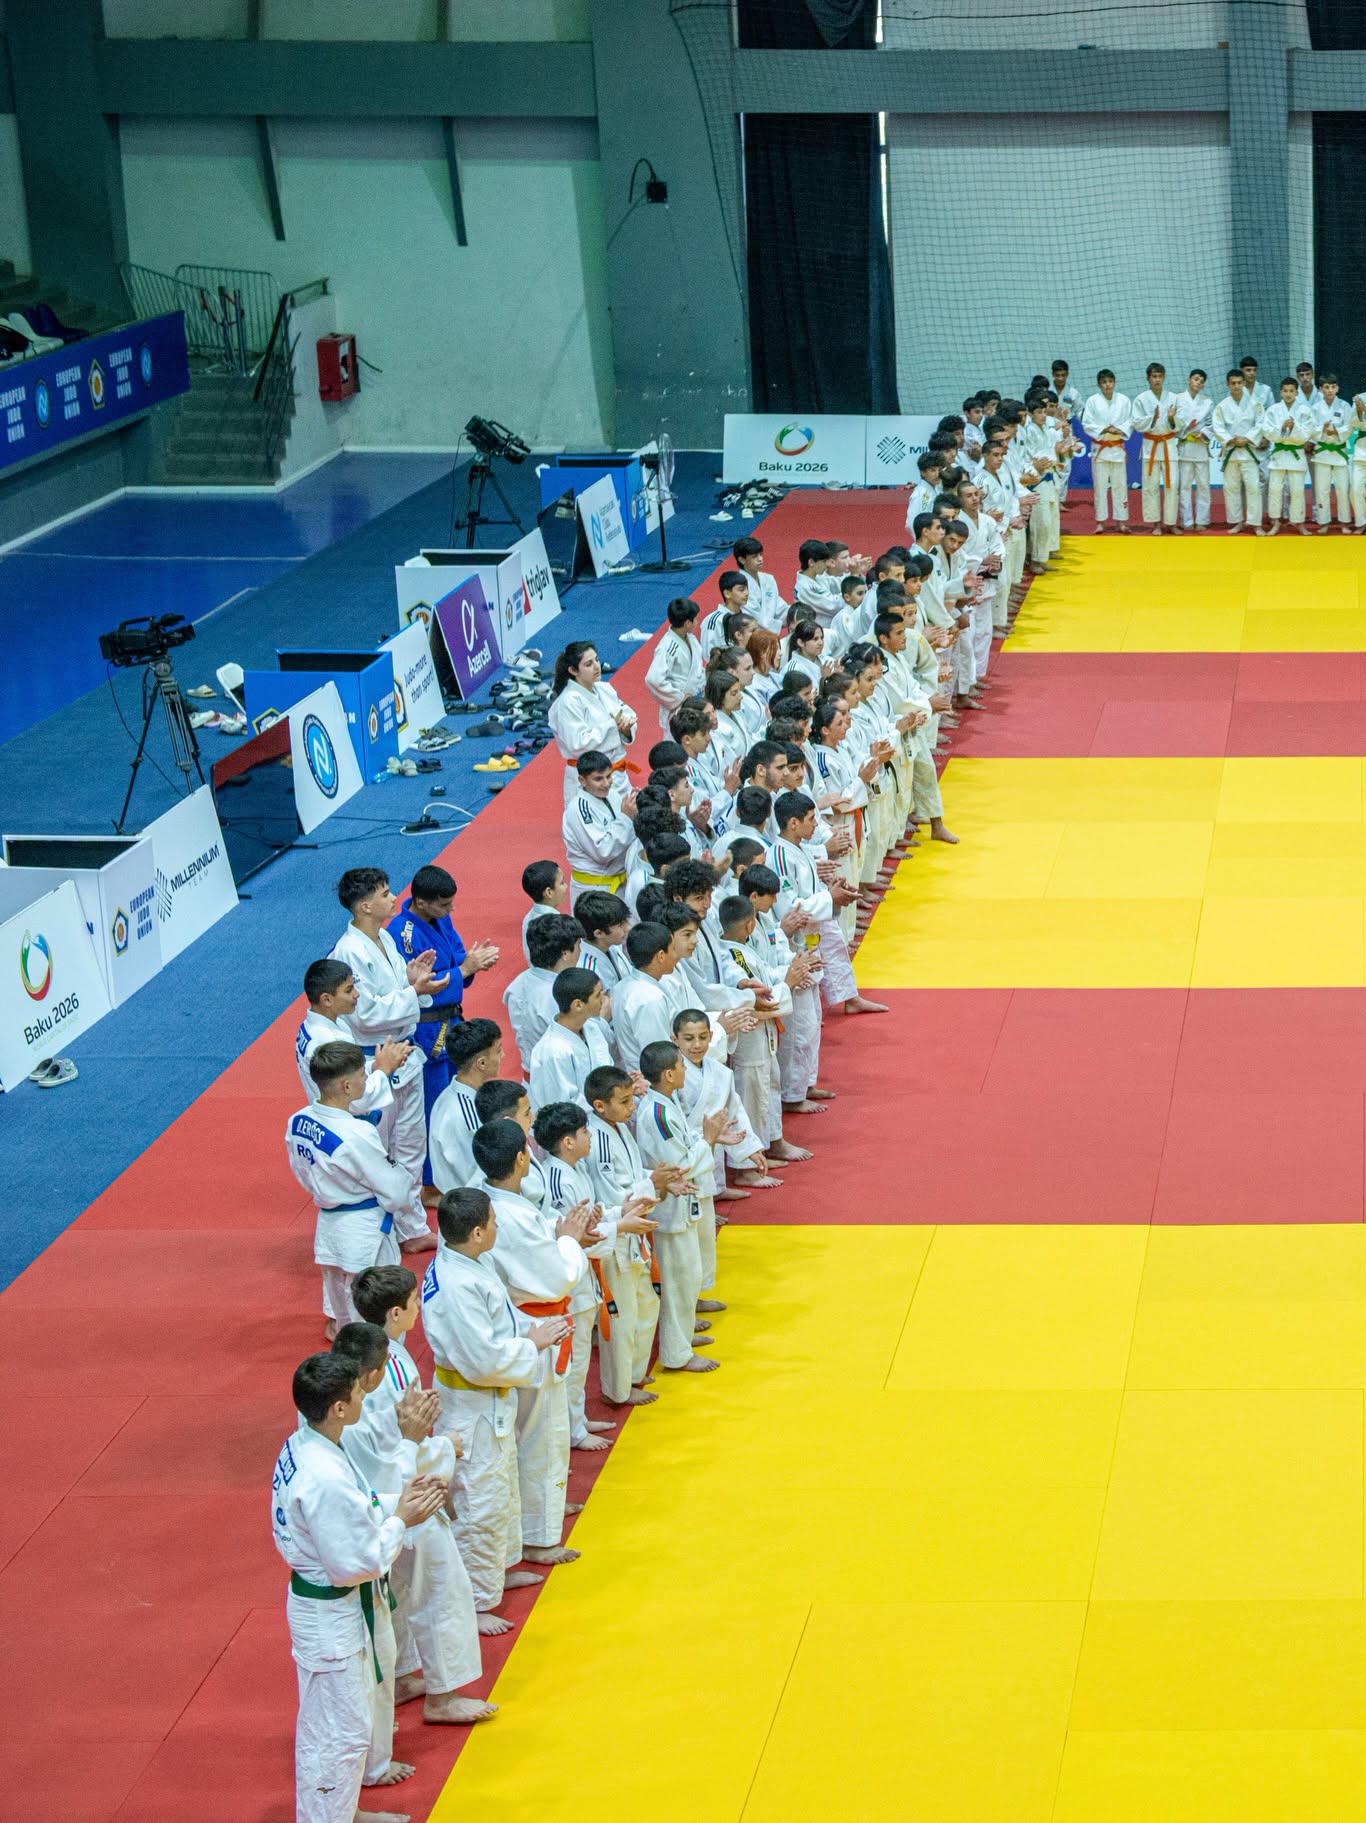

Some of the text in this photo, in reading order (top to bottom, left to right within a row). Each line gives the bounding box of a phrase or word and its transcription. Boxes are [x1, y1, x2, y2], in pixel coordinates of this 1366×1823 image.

[759, 462, 828, 472] Baku 2026
[525, 565, 550, 600] triglav
[170, 844, 220, 892] MILLENNIUM
[129, 885, 155, 913] EUROPEAN
[137, 905, 150, 924] JUDO
[137, 919, 153, 940] UNION
[24, 1016, 53, 1045] Baku
[52, 992, 79, 1024] 2026
